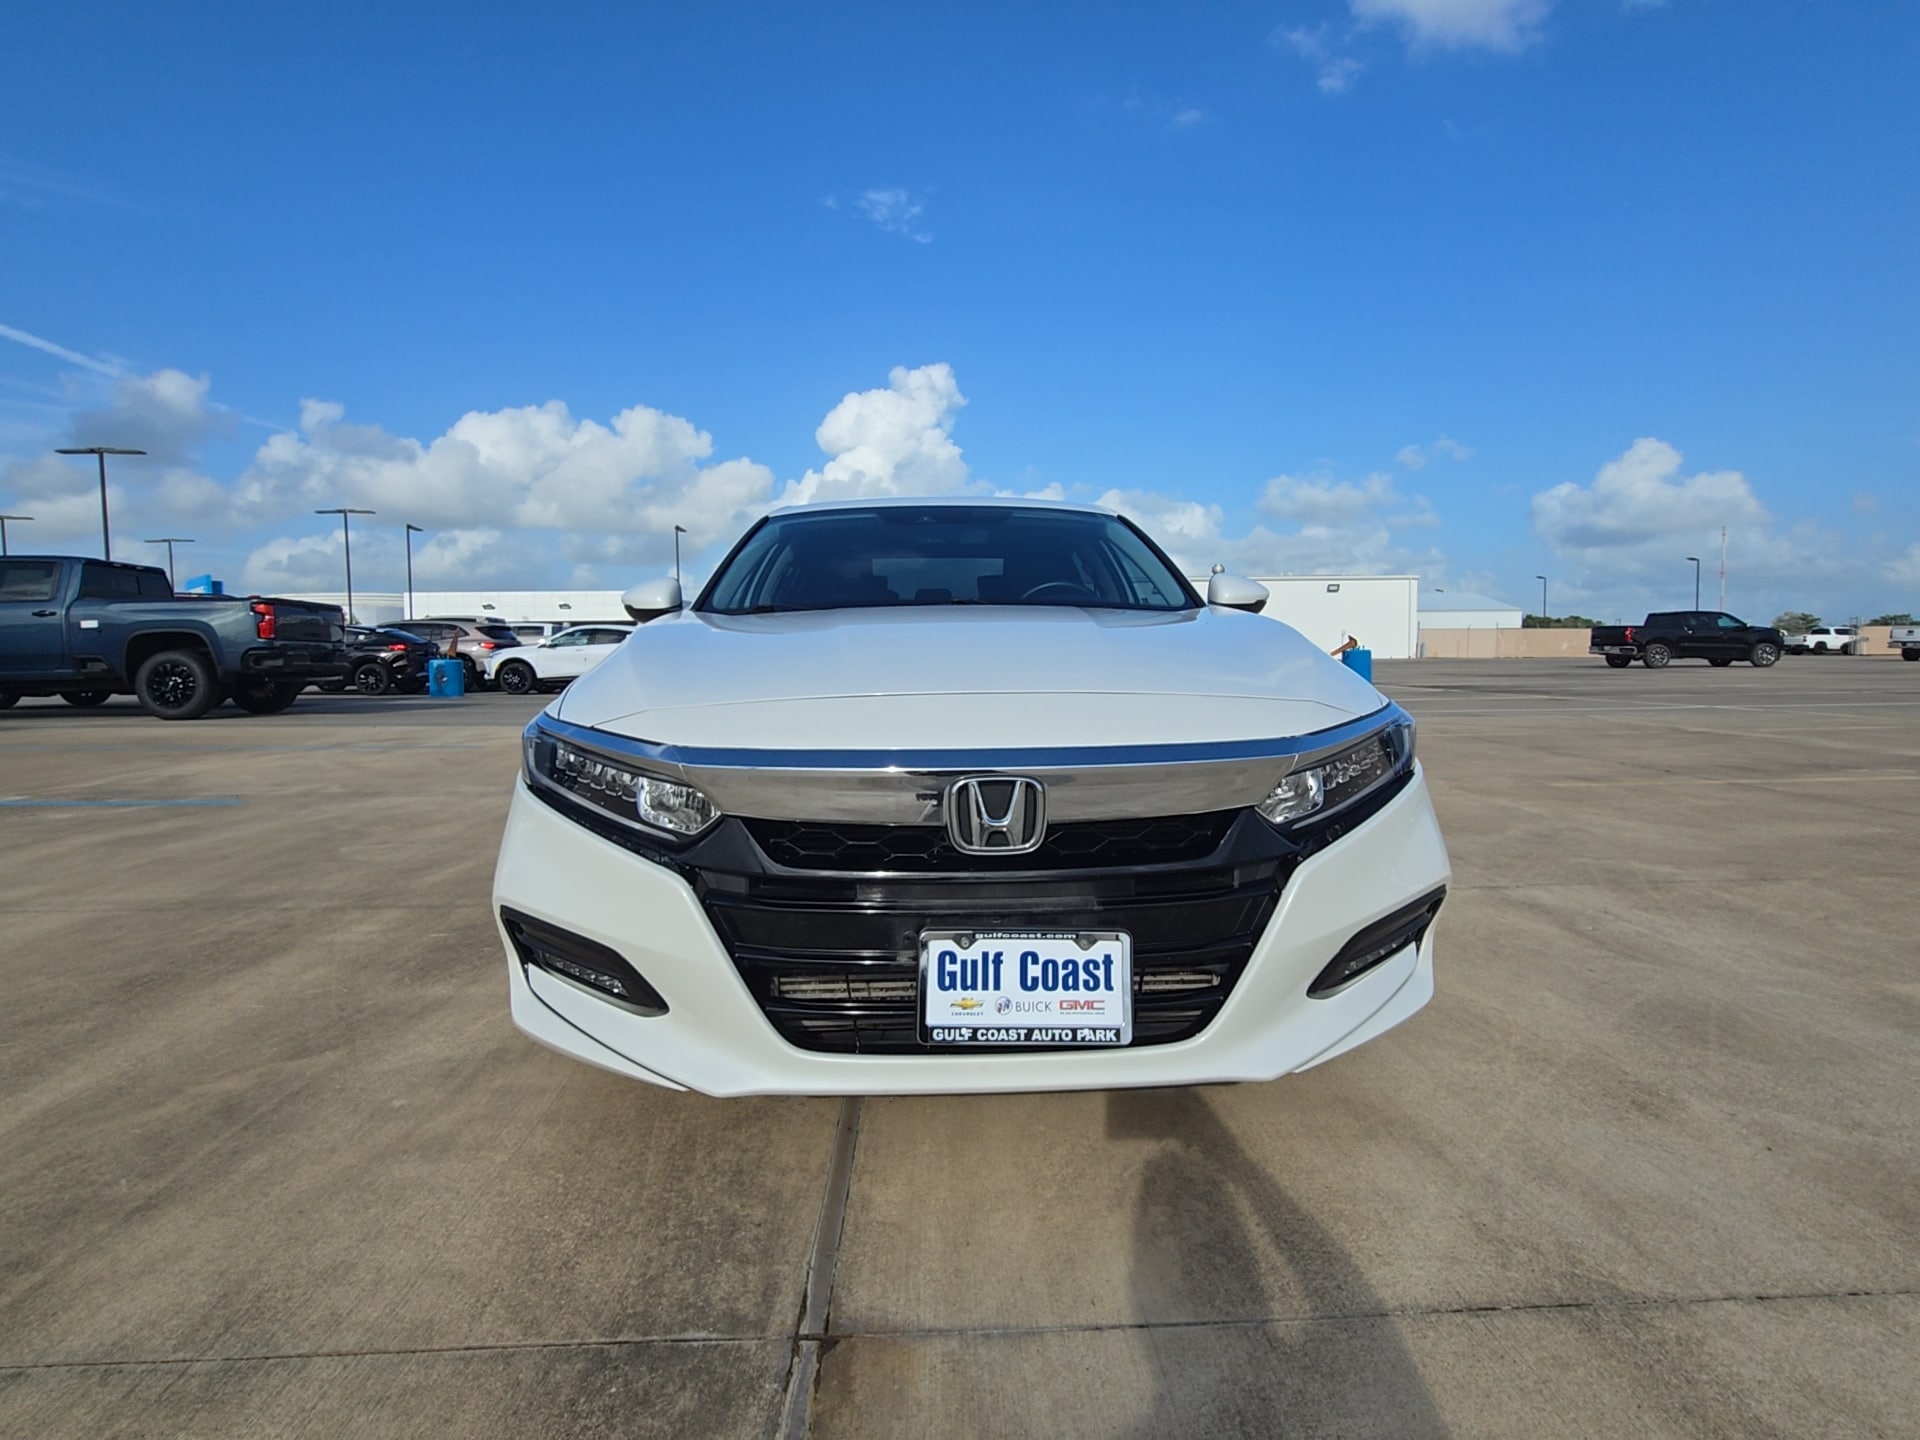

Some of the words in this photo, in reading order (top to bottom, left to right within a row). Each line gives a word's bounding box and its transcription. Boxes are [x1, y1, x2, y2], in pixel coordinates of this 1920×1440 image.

[937, 950, 1003, 992] Gulf
[1019, 951, 1114, 992] Coast
[1015, 1001, 1052, 1013] BUICK
[1059, 1000, 1105, 1010] GMC
[932, 1028, 973, 1041] GULF
[977, 1029, 1027, 1041] COAST
[1031, 1029, 1072, 1041] AUTO
[1077, 1028, 1117, 1041] PARK
